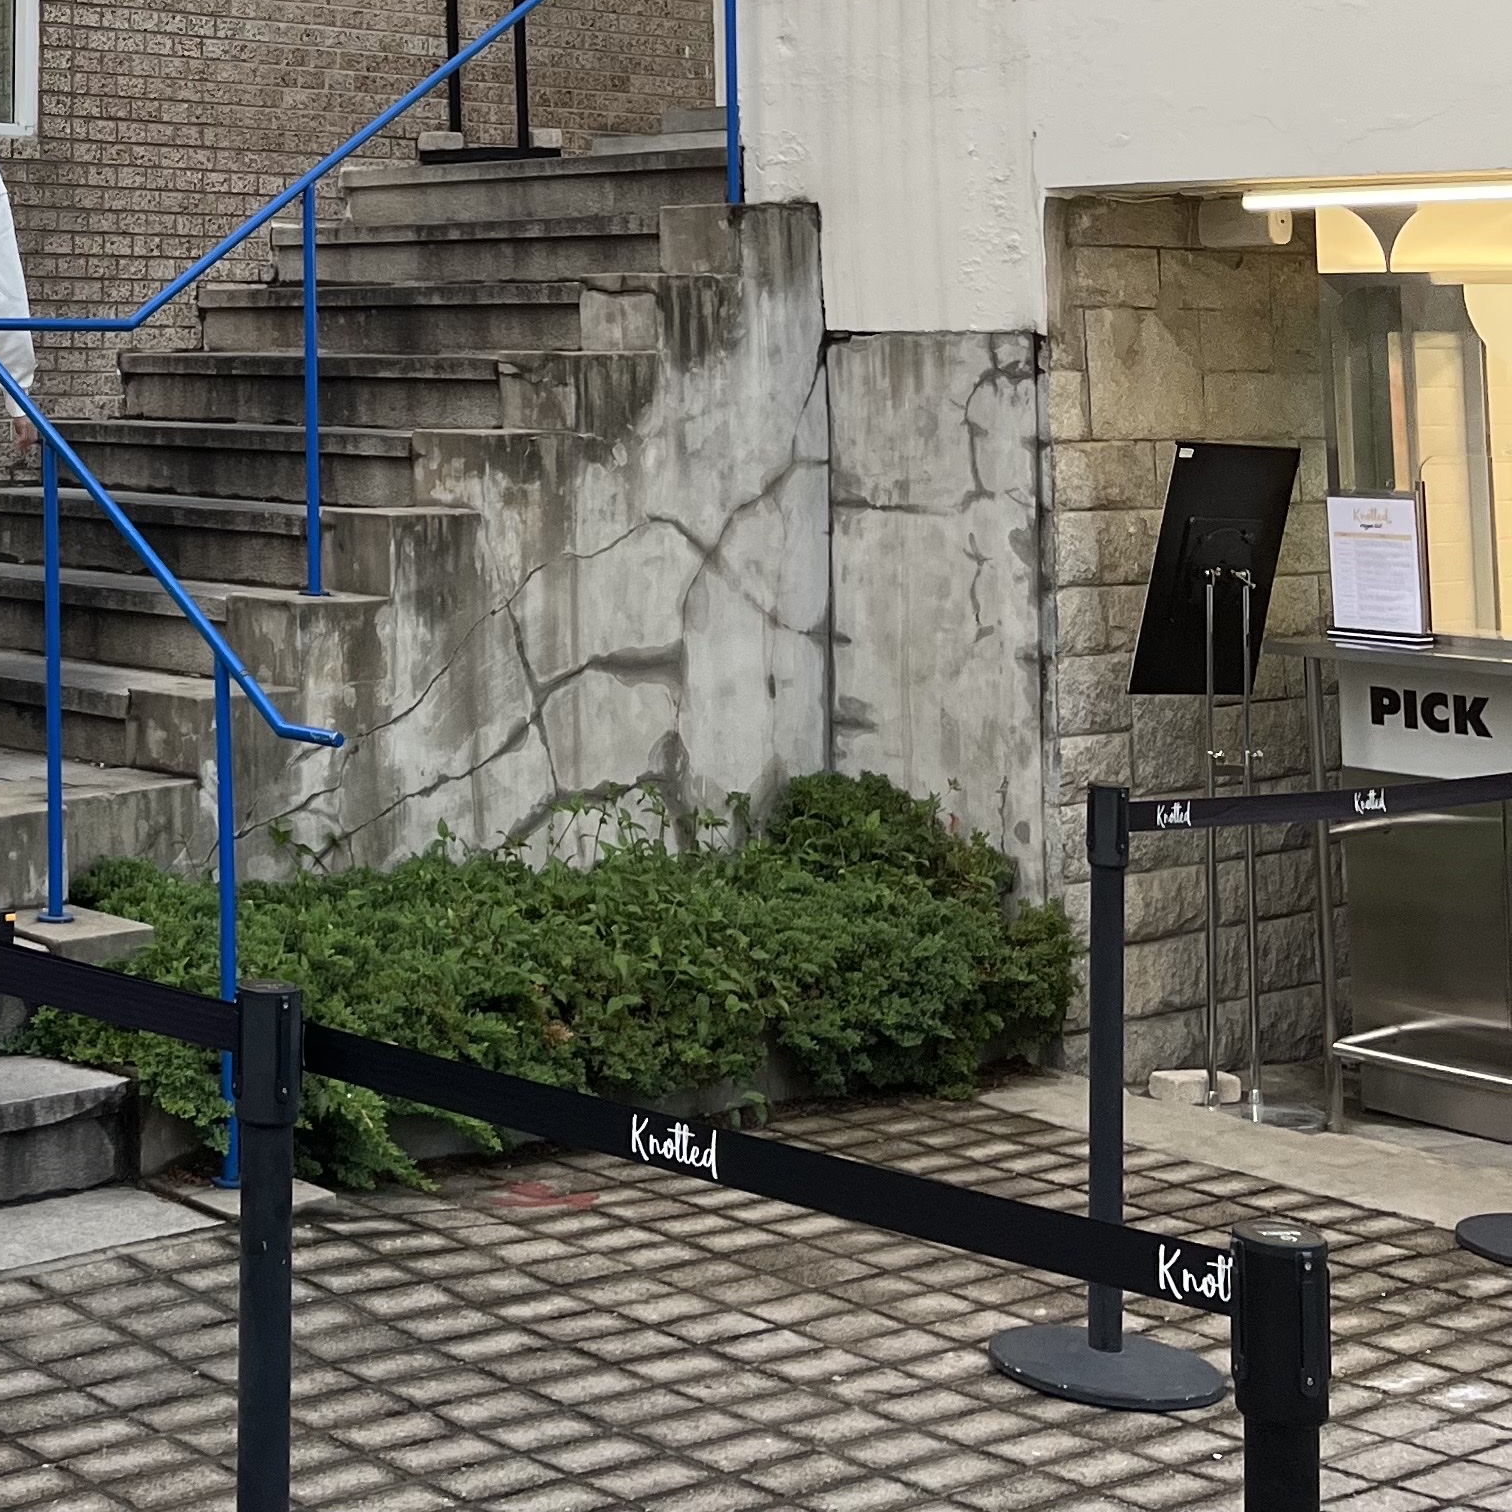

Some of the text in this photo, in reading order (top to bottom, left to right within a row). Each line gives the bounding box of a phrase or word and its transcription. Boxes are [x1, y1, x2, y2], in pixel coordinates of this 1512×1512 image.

[1370, 686, 1493, 738] PICK
[1156, 800, 1192, 829] Knotted
[1354, 788, 1387, 814] Knotted
[631, 1113, 719, 1180] Knotted
